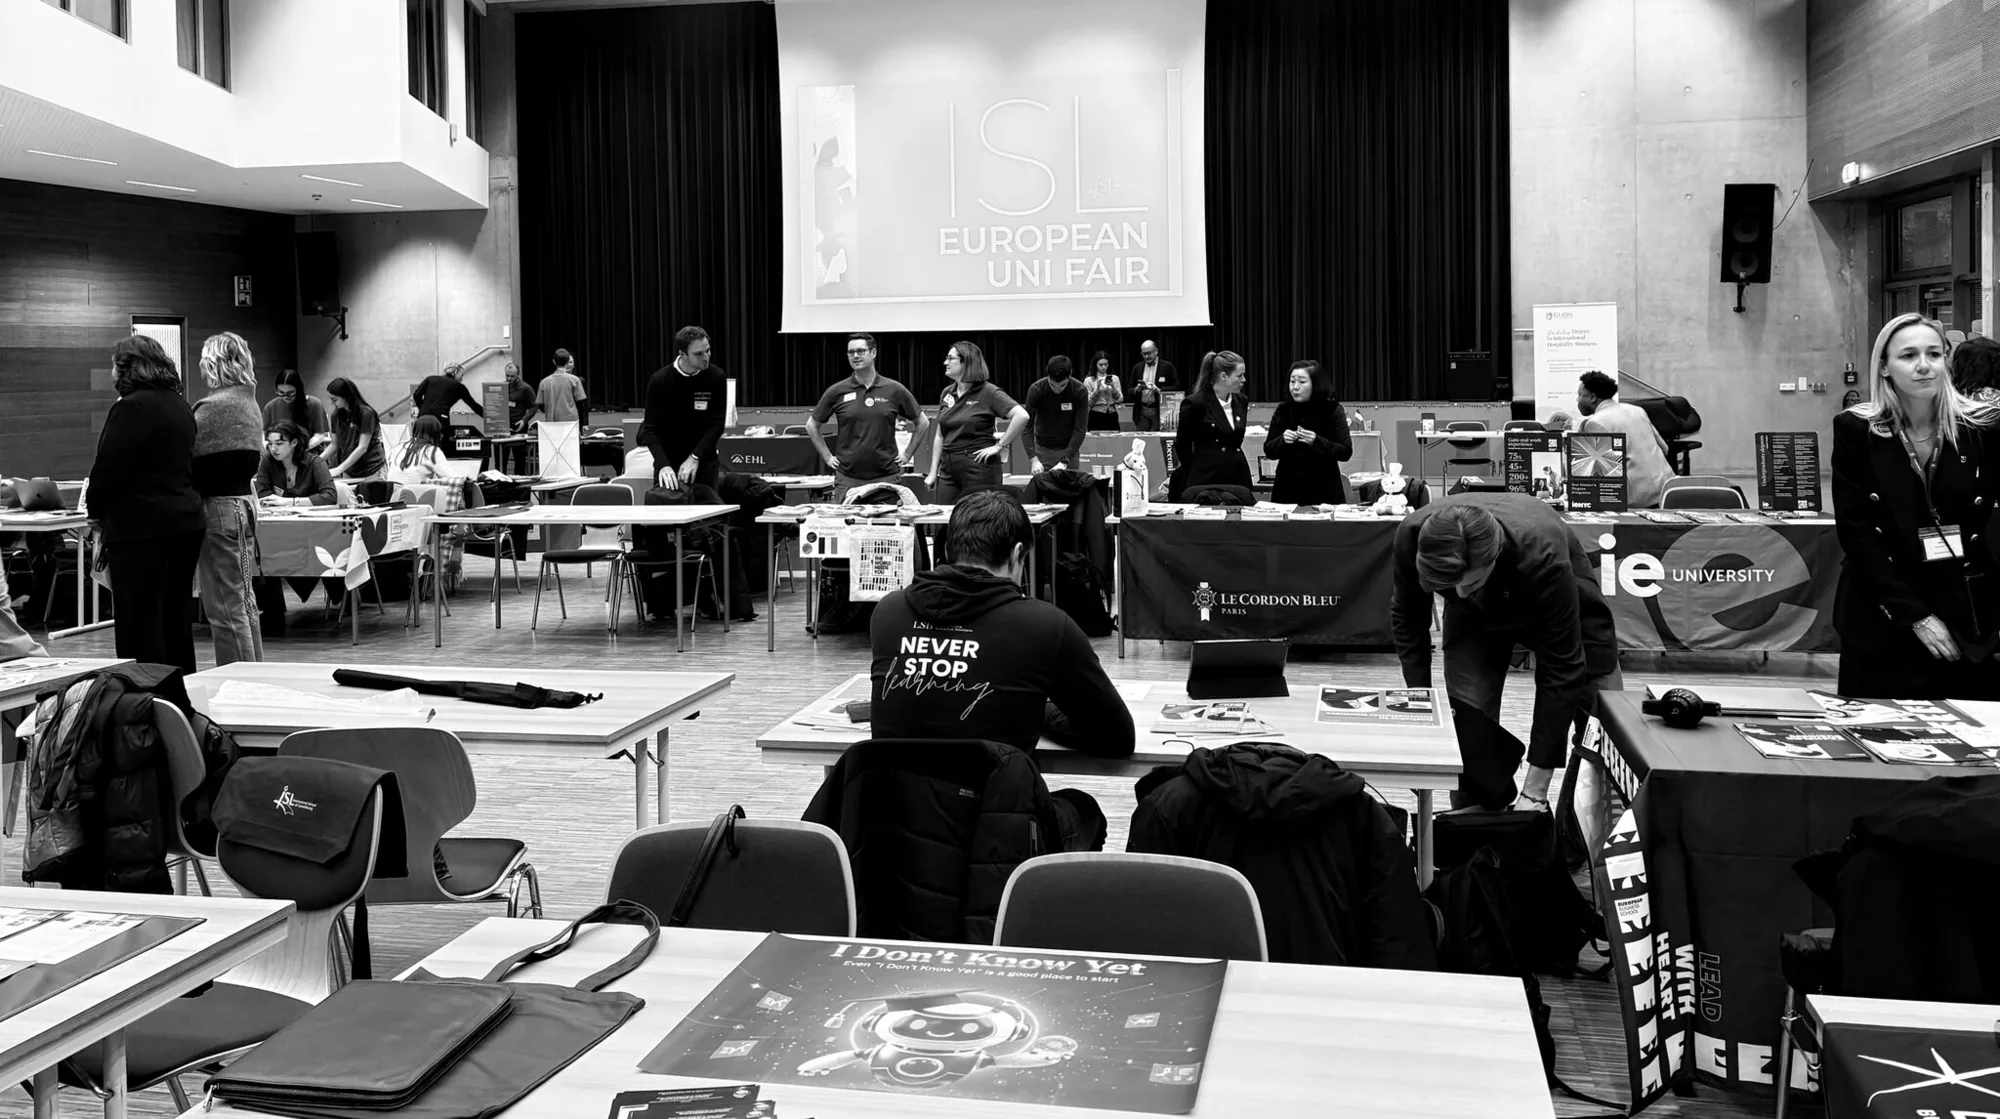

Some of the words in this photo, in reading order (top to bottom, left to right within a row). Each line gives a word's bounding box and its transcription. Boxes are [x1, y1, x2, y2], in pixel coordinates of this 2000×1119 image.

[949, 96, 1149, 218] ISL
[939, 222, 1149, 255] EUROPEAN
[987, 258, 1052, 288] UNI
[1065, 256, 1150, 286] FAIR
[745, 455, 766, 465] EHL
[1166, 439, 1176, 471] Bocconi
[1599, 533, 1665, 598] ie
[1672, 569, 1775, 582] UNIVERSITY
[1221, 593, 1238, 605] LE
[1239, 593, 1300, 606] CORDON
[1302, 594, 1339, 606] BLEU
[900, 636, 980, 659] NEVER
[904, 657, 968, 679] STOP
[882, 656, 994, 720] learning
[1617, 897, 1643, 907] EUROPEAN
[829, 944, 852, 957] I
[853, 945, 959, 964] Don't
[963, 952, 1076, 971] Know
[1085, 959, 1147, 976] Yet
[843, 960, 871, 968] Even
[886, 963, 918, 971] Don't
[920, 965, 954, 973] Know
[957, 967, 983, 975] Yet"
[1007, 971, 1039, 979] good
[1040, 973, 1073, 981] place
[1656, 931, 1676, 1020] HEART
[1675, 943, 1696, 1015] WITH
[1699, 951, 1722, 1023] LEAD
